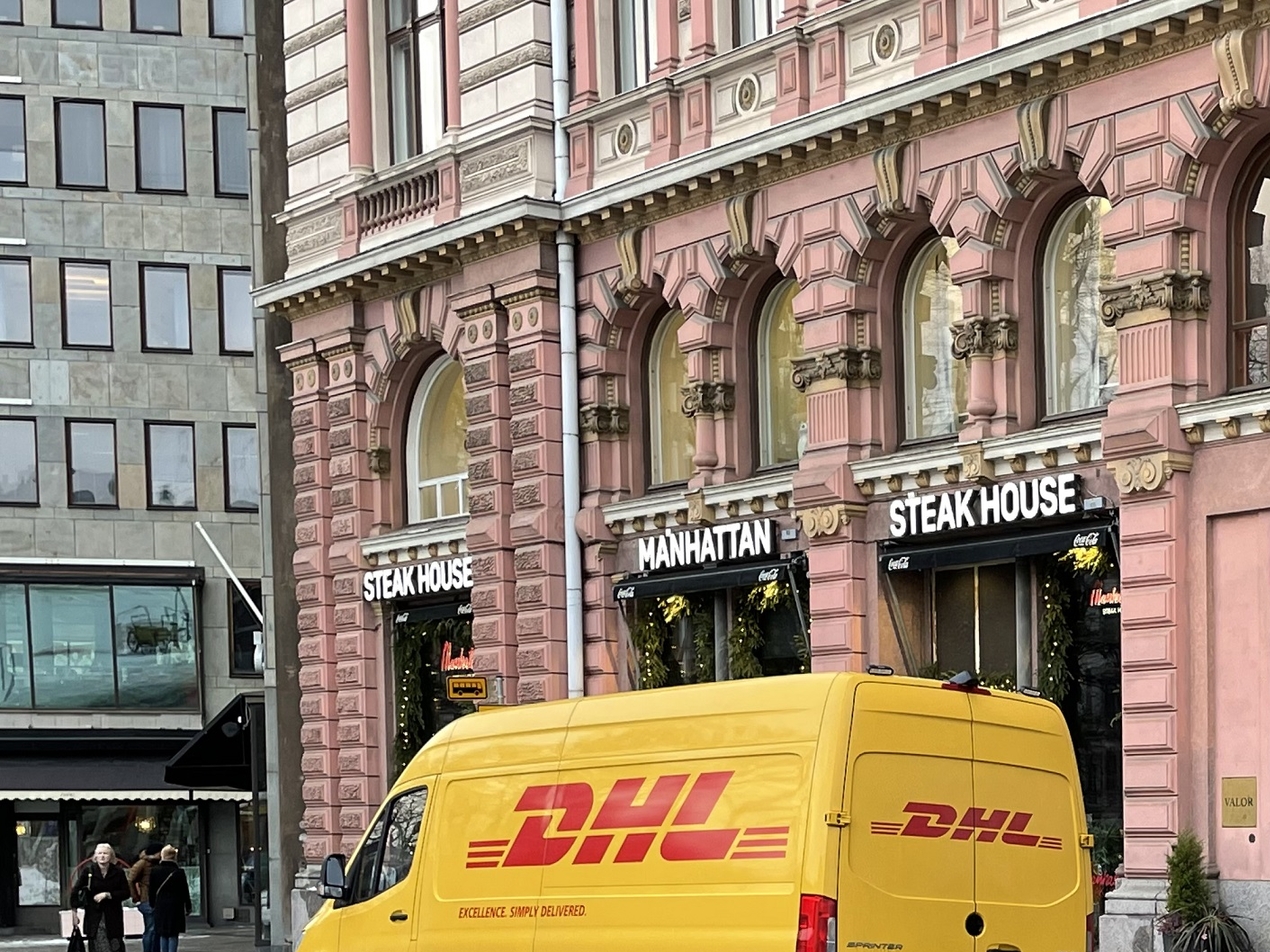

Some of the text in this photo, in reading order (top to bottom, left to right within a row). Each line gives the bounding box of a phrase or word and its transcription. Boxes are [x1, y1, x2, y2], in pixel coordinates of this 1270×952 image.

[889, 472, 1076, 537] STEAK HOUSE
[638, 518, 771, 572] MANHATTAN
[363, 556, 474, 602] STEAK HOUSE
[501, 770, 741, 868] DHL
[900, 801, 1041, 847] DHL
[1224, 797, 1254, 807] VALOR
[458, 904, 587, 919] EXCELLENCE. SIMPLY DELIVERED.
[846, 941, 903, 951] SPRINTER
